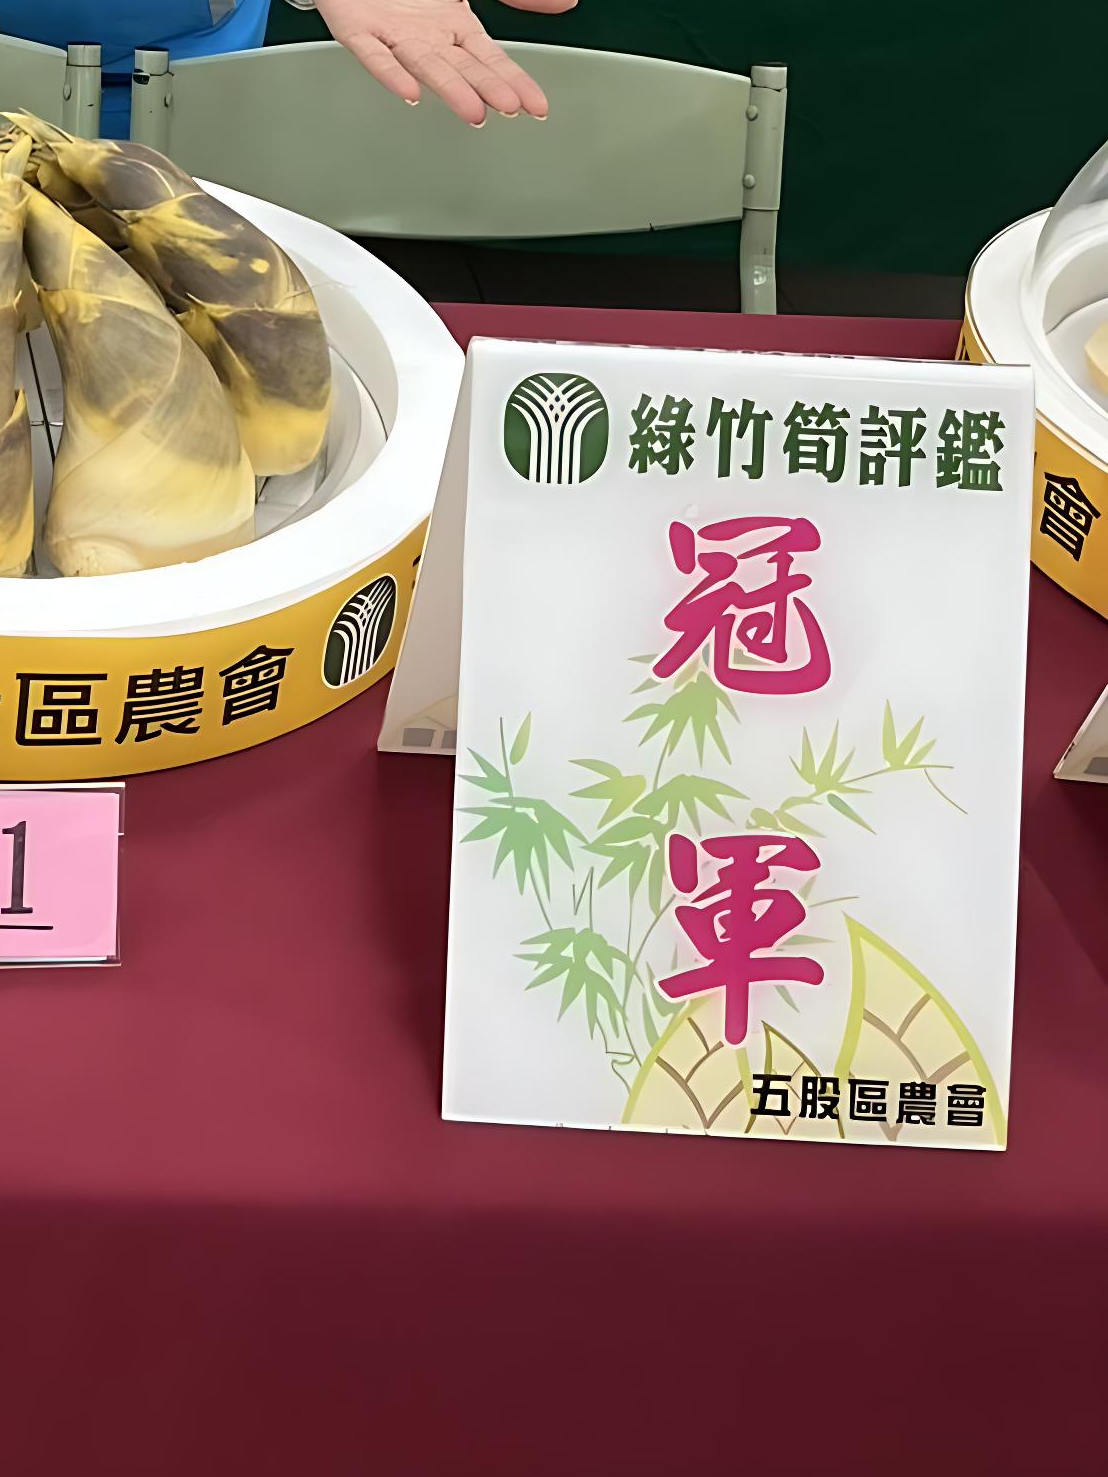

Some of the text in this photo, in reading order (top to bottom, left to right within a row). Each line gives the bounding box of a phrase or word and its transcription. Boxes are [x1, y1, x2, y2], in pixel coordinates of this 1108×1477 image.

[628, 394, 1006, 492] 綠竹筍評鑑
[652, 516, 832, 1045] 冠軍
[750, 1073, 988, 1128] 五股區農會
